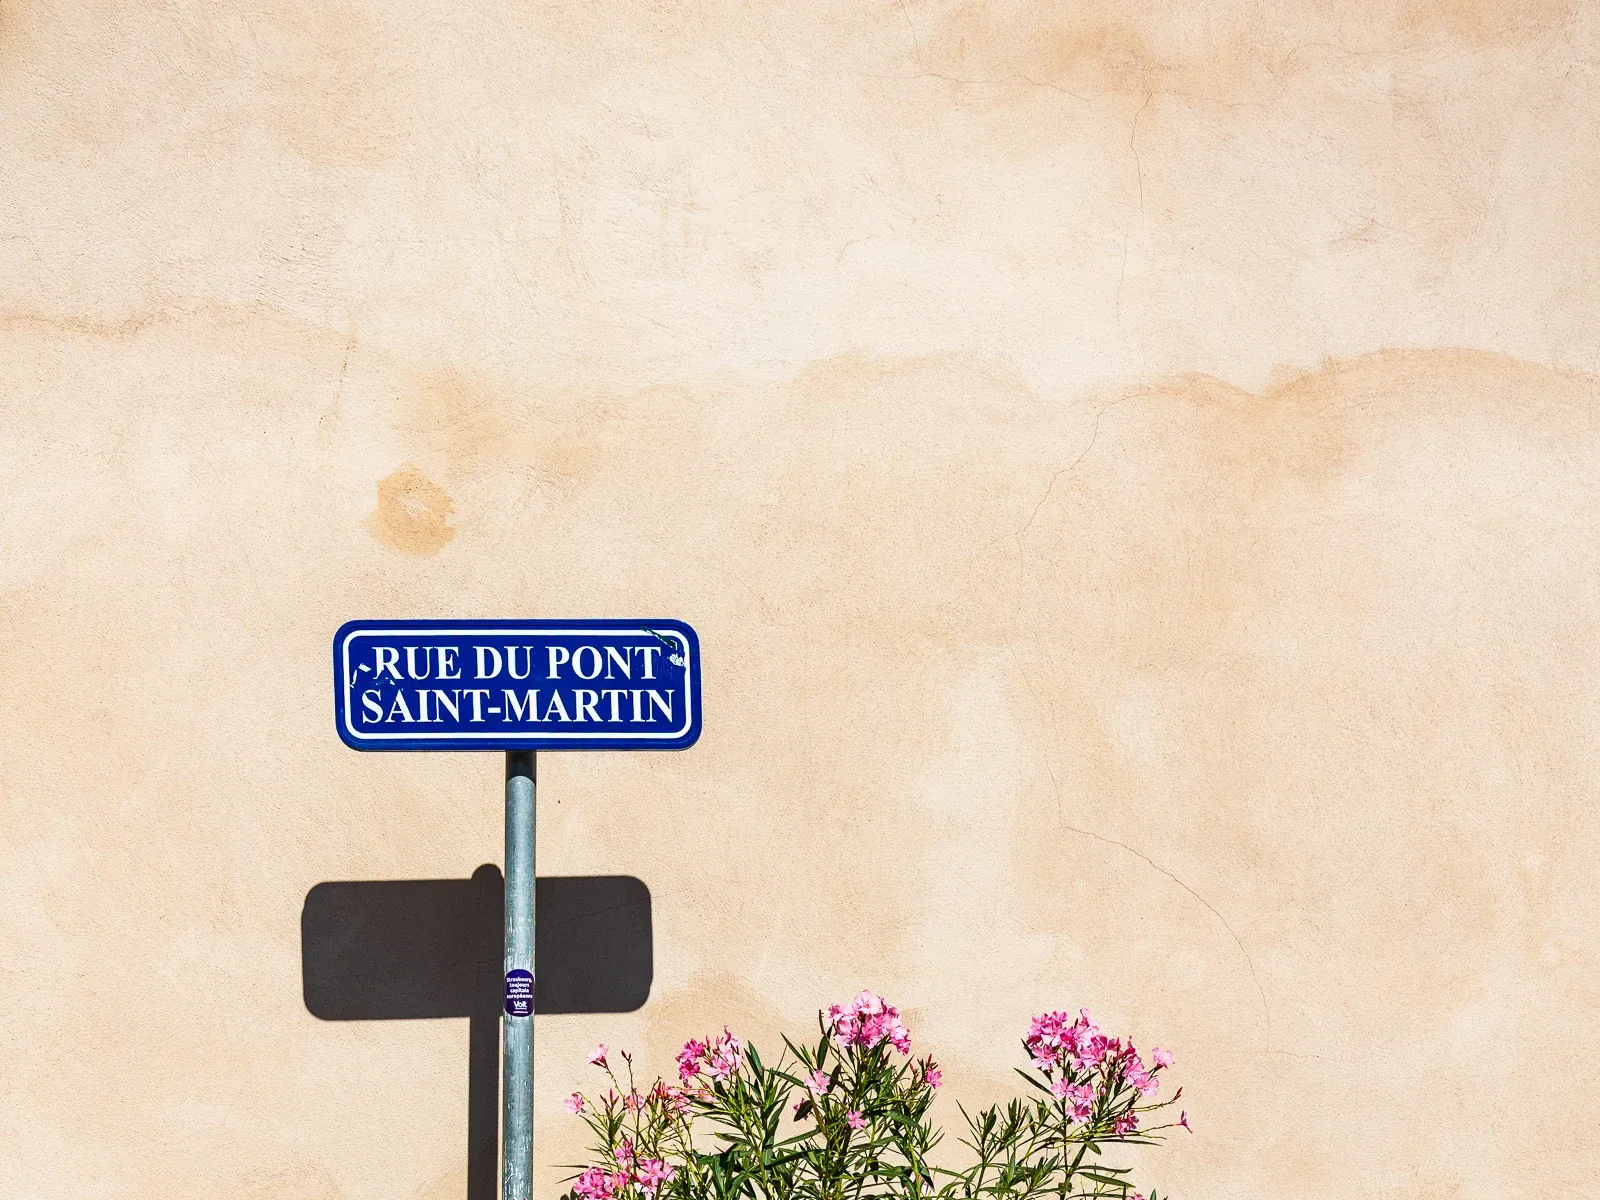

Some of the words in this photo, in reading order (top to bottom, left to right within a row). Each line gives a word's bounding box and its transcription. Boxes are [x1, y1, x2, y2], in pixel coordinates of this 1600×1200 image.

[371, 645, 461, 680] RUE
[474, 645, 534, 680] DU
[545, 645, 661, 680] PONT
[360, 688, 676, 724] SAINT-MARTIN
[513, 1000, 527, 1008] Volt
